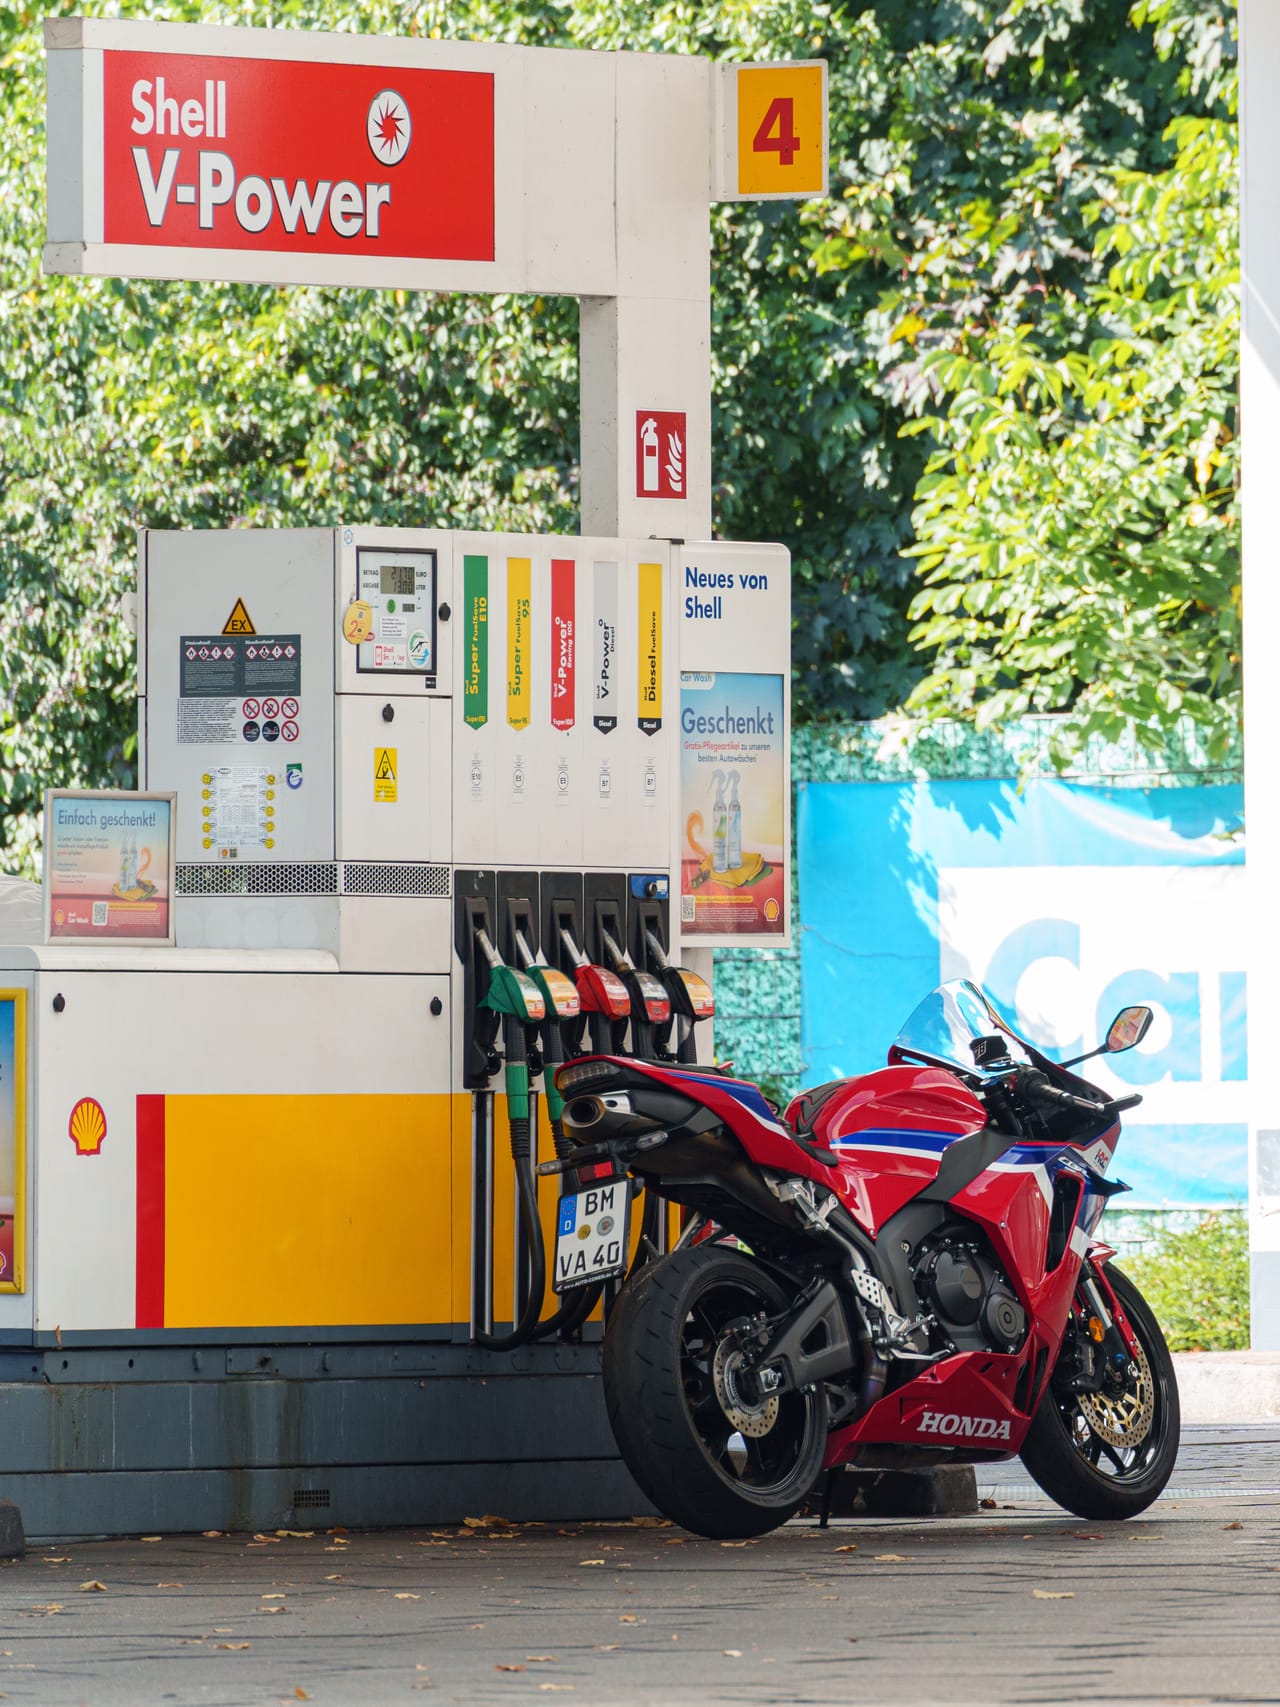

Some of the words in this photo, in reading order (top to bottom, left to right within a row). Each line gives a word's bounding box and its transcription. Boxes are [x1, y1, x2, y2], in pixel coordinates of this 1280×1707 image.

[131, 77, 226, 138] Shell
[752, 98, 801, 166] 4
[131, 146, 390, 238] V-Power
[685, 567, 734, 589] Neues
[739, 574, 768, 590] von
[479, 596, 487, 623] E10
[522, 599, 530, 618] 95
[685, 595, 722, 619] Shell
[231, 620, 247, 631] EX
[557, 620, 567, 698] V-Power
[566, 638, 574, 668] Racing
[601, 623, 610, 699] V-Power
[470, 644, 481, 695] Super
[512, 646, 523, 696] Super
[648, 655, 657, 702] Diesel
[680, 673, 693, 682] Car
[693, 672, 712, 682] Wash
[643, 721, 657, 729] Diesel
[681, 705, 774, 735] Geschenkt
[684, 741, 740, 752] Gratis-Pflegeartikel
[741, 743, 748, 751] zu
[748, 743, 771, 751] unseren
[698, 752, 718, 762] besten
[58, 808, 97, 826] Einfach
[100, 810, 156, 830] geschenkt!
[585, 1187, 615, 1216] BM
[564, 1220, 572, 1231] D
[560, 1250, 586, 1278] VA
[593, 1241, 619, 1267] 40
[916, 1411, 1011, 1440] HONDA
